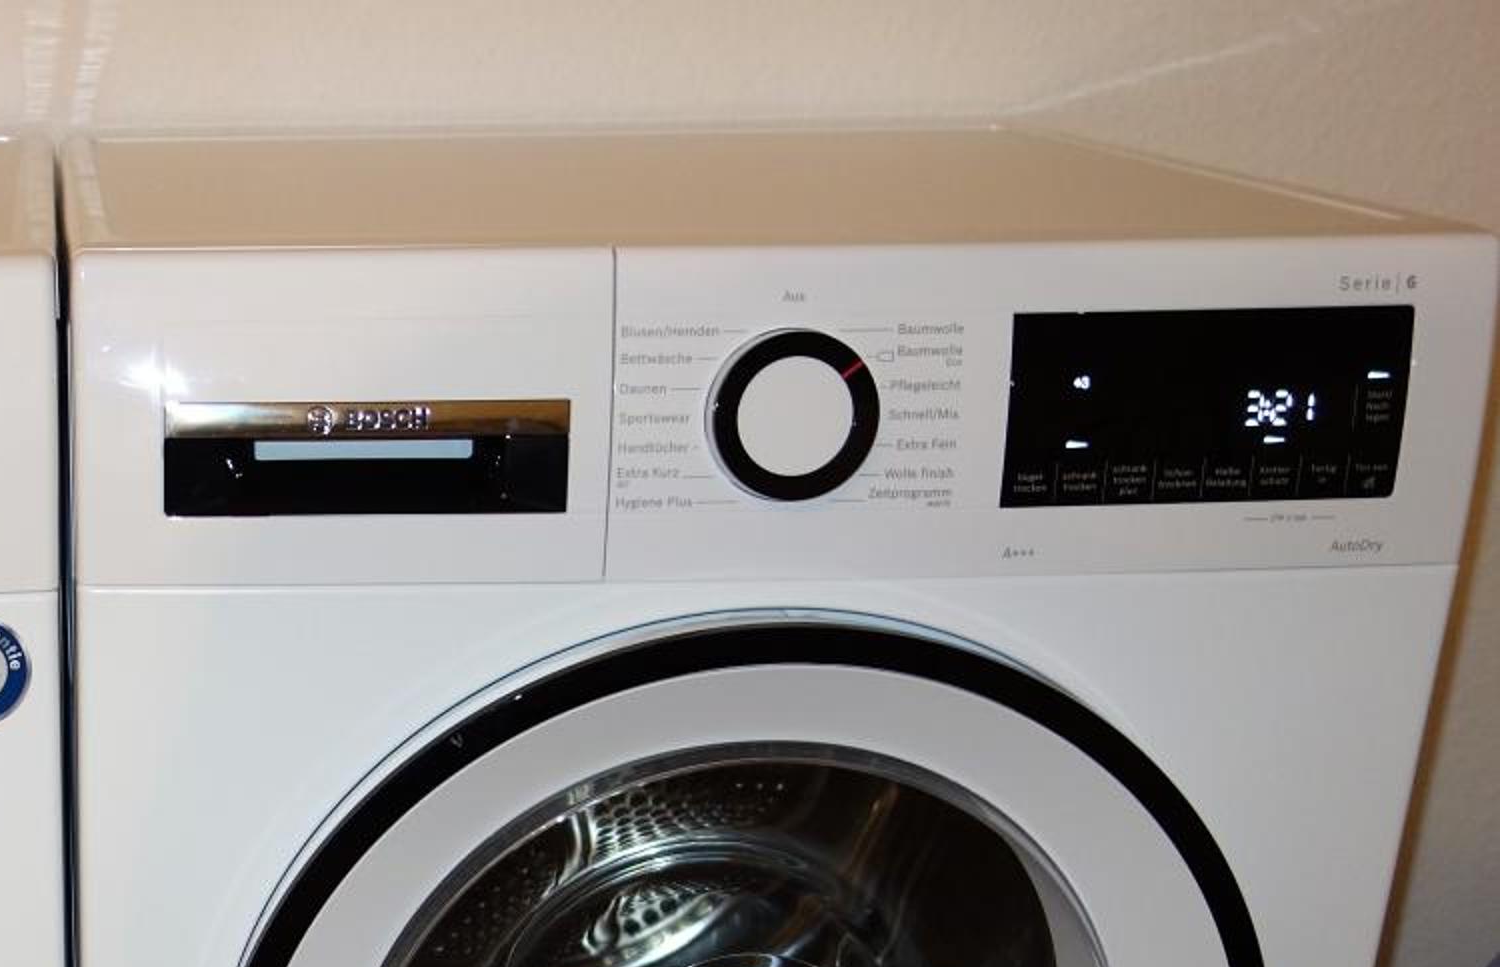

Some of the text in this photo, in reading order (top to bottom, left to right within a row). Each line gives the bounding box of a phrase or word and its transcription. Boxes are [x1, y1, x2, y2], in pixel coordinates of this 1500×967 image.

[1339, 275, 1417, 291] Serie 6
[782, 290, 806, 303] Aus
[619, 382, 668, 396] Daunen
[344, 406, 431, 431] BOSCH
[1331, 540, 1383, 553] AutoDry
